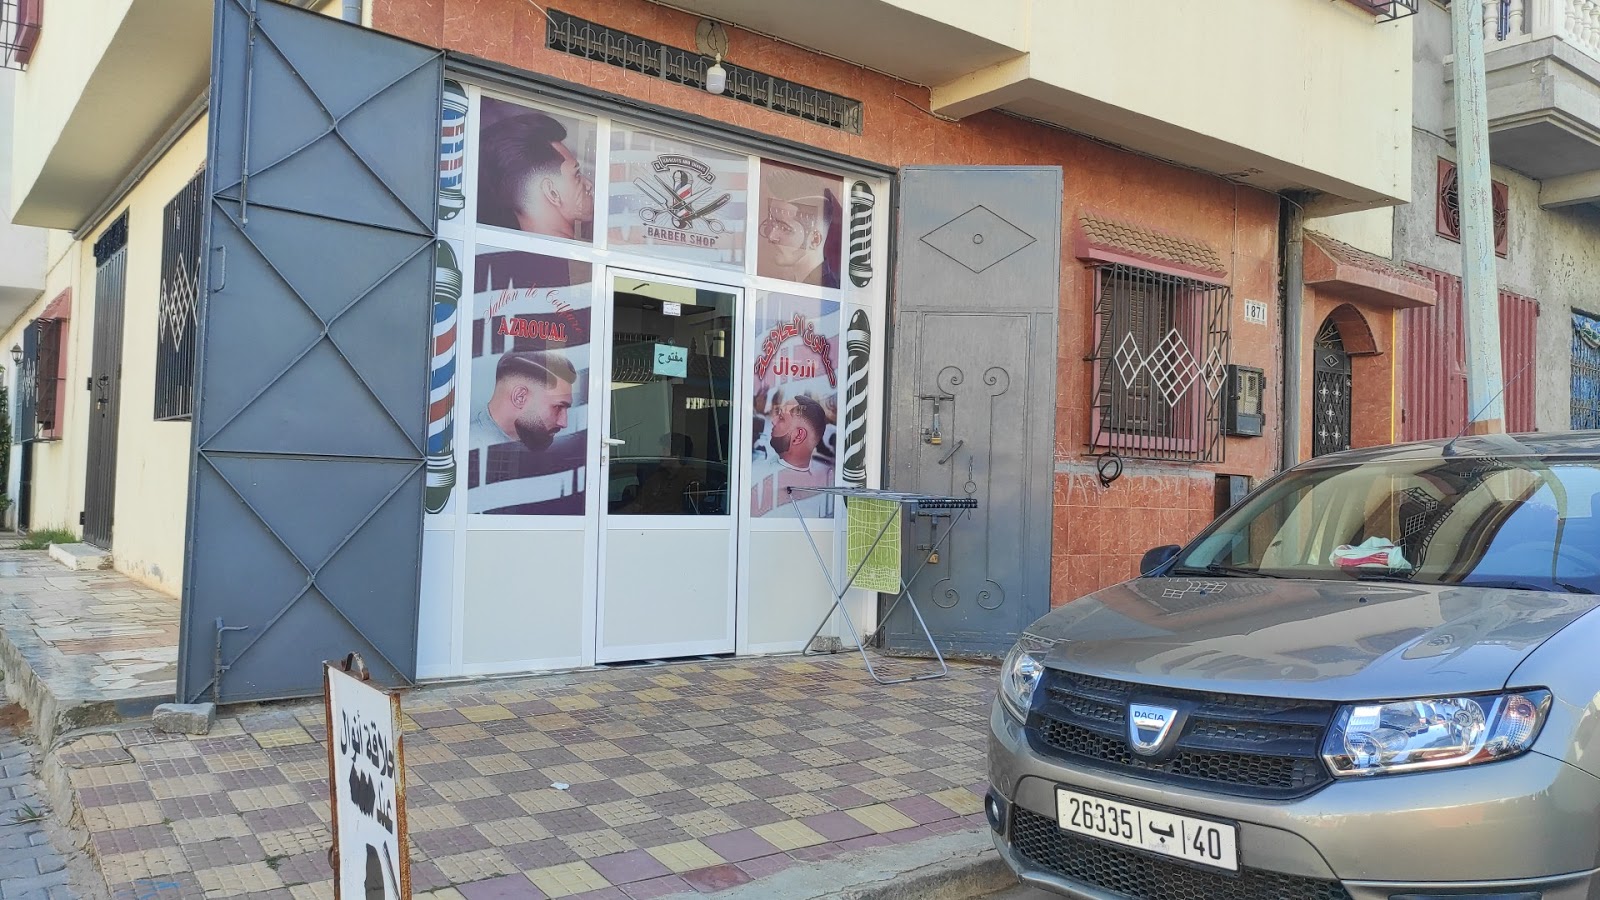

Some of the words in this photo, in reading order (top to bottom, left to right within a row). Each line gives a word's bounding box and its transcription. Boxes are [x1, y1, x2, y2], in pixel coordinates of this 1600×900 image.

[647, 226, 687, 243] BARBER
[689, 235, 716, 247] SHOP
[524, 282, 538, 298] de
[1246, 304, 1265, 320] 1871
[497, 316, 568, 342] AZROUAL
[657, 351, 683, 365] مفتوح
[1134, 710, 1165, 722] DACIA
[1069, 797, 1134, 840] 26335
[1148, 820, 1175, 844] ب
[1192, 825, 1222, 861] 40
